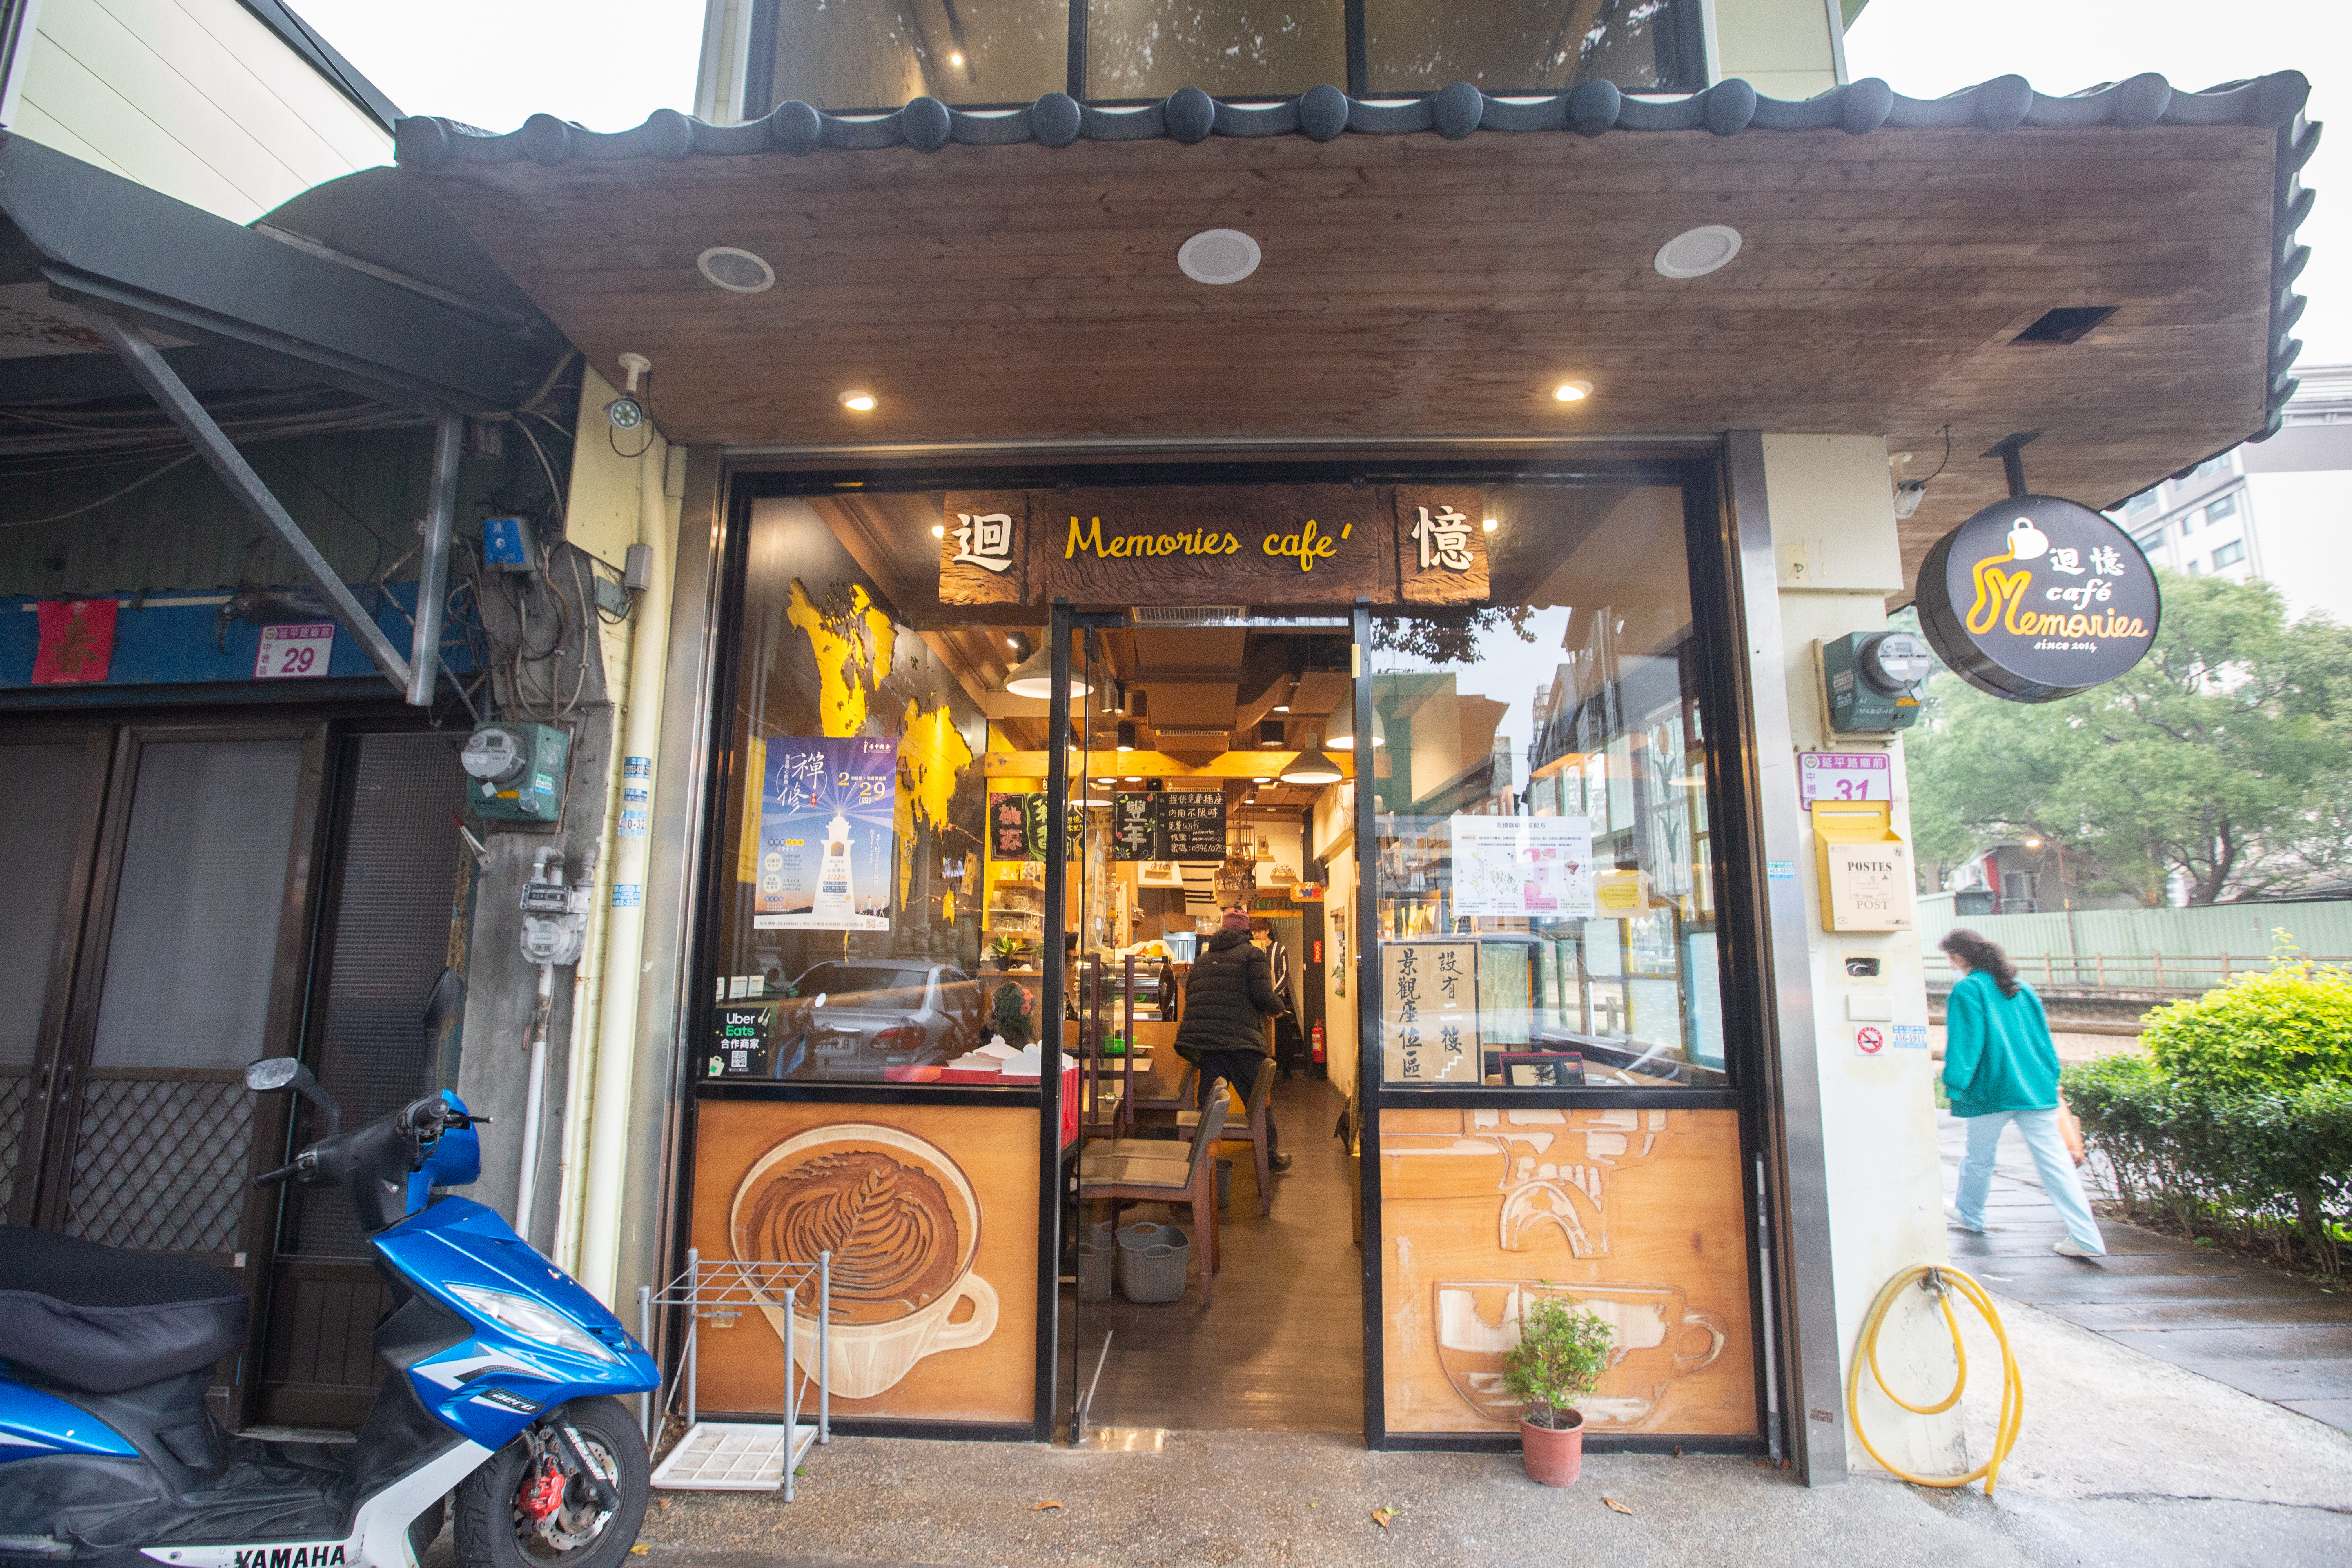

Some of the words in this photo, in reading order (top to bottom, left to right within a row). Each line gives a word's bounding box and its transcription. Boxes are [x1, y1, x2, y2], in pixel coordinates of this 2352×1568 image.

[951, 512, 1012, 571] 迴
[1065, 515, 1242, 559] Memories
[1411, 505, 1474, 570] 憶
[2049, 546, 2125, 576] 迴憶
[1966, 562, 2149, 638] Memories
[2045, 578, 2113, 611] café
[49, 612, 100, 674] 春
[2034, 639, 2069, 650] since
[2071, 641, 2098, 653] 2014
[281, 647, 315, 673] 29
[1822, 757, 1884, 768] 延平路廟前
[777, 751, 825, 816] 禪修
[1830, 778, 1869, 800] 31
[1169, 793, 1223, 805] 提供免費插座
[999, 804, 1022, 851] 桃源
[1847, 862, 1892, 872] POSTES
[1856, 900, 1889, 910] POST
[1395, 948, 1421, 1079] 景觀座位區
[1438, 951, 1464, 1054] 設有二樓
[726, 1013, 755, 1024] Uber
[726, 1025, 755, 1036] Eats
[720, 1038, 760, 1049] 合作商家
[1894, 1034, 1924, 1042] 456-5911
[234, 1544, 346, 1568] YAMAHA
